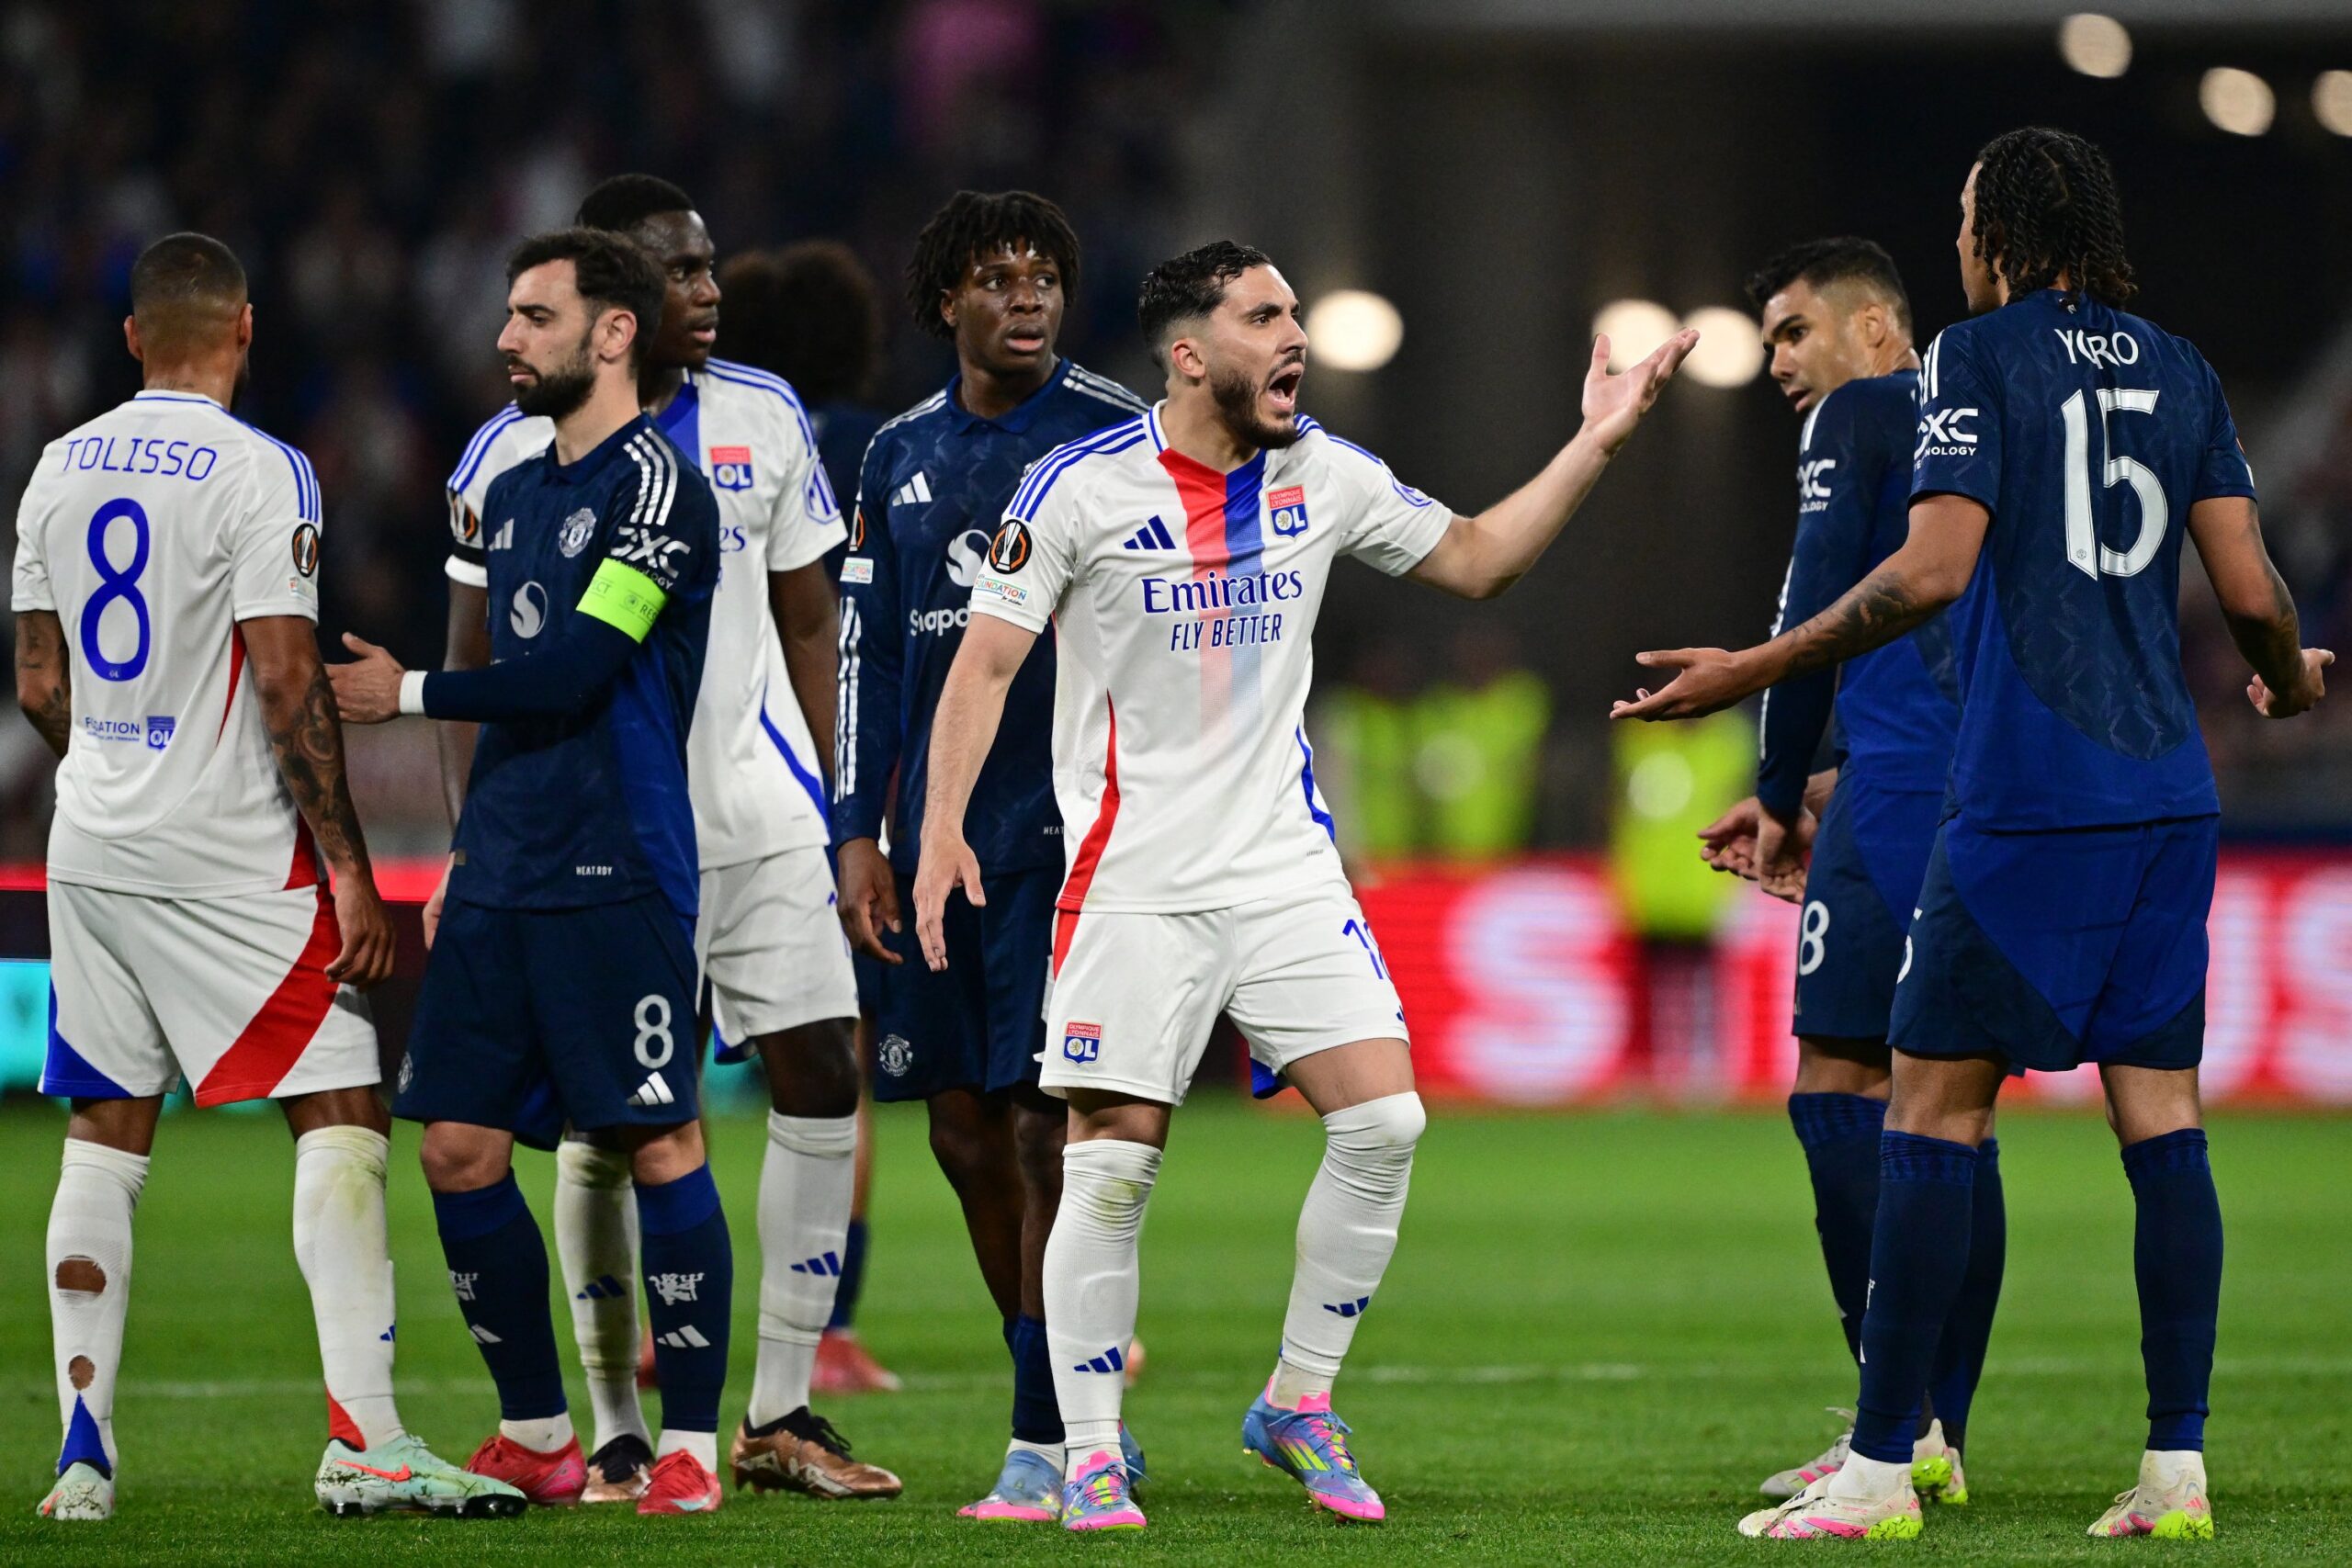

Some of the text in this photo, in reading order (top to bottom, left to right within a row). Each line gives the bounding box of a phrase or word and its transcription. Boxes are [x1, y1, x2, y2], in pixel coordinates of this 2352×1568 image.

[63, 436, 218, 481] TOLISSO
[717, 465, 752, 487] OL
[2061, 388, 2168, 581] 15
[1275, 506, 1306, 531] OL
[80, 497, 150, 682] 8
[1141, 570, 1303, 614] Emirates
[1170, 613, 1283, 651] FLY BETTER
[634, 994, 674, 1069] 8
[1067, 1038, 1096, 1058] OL
